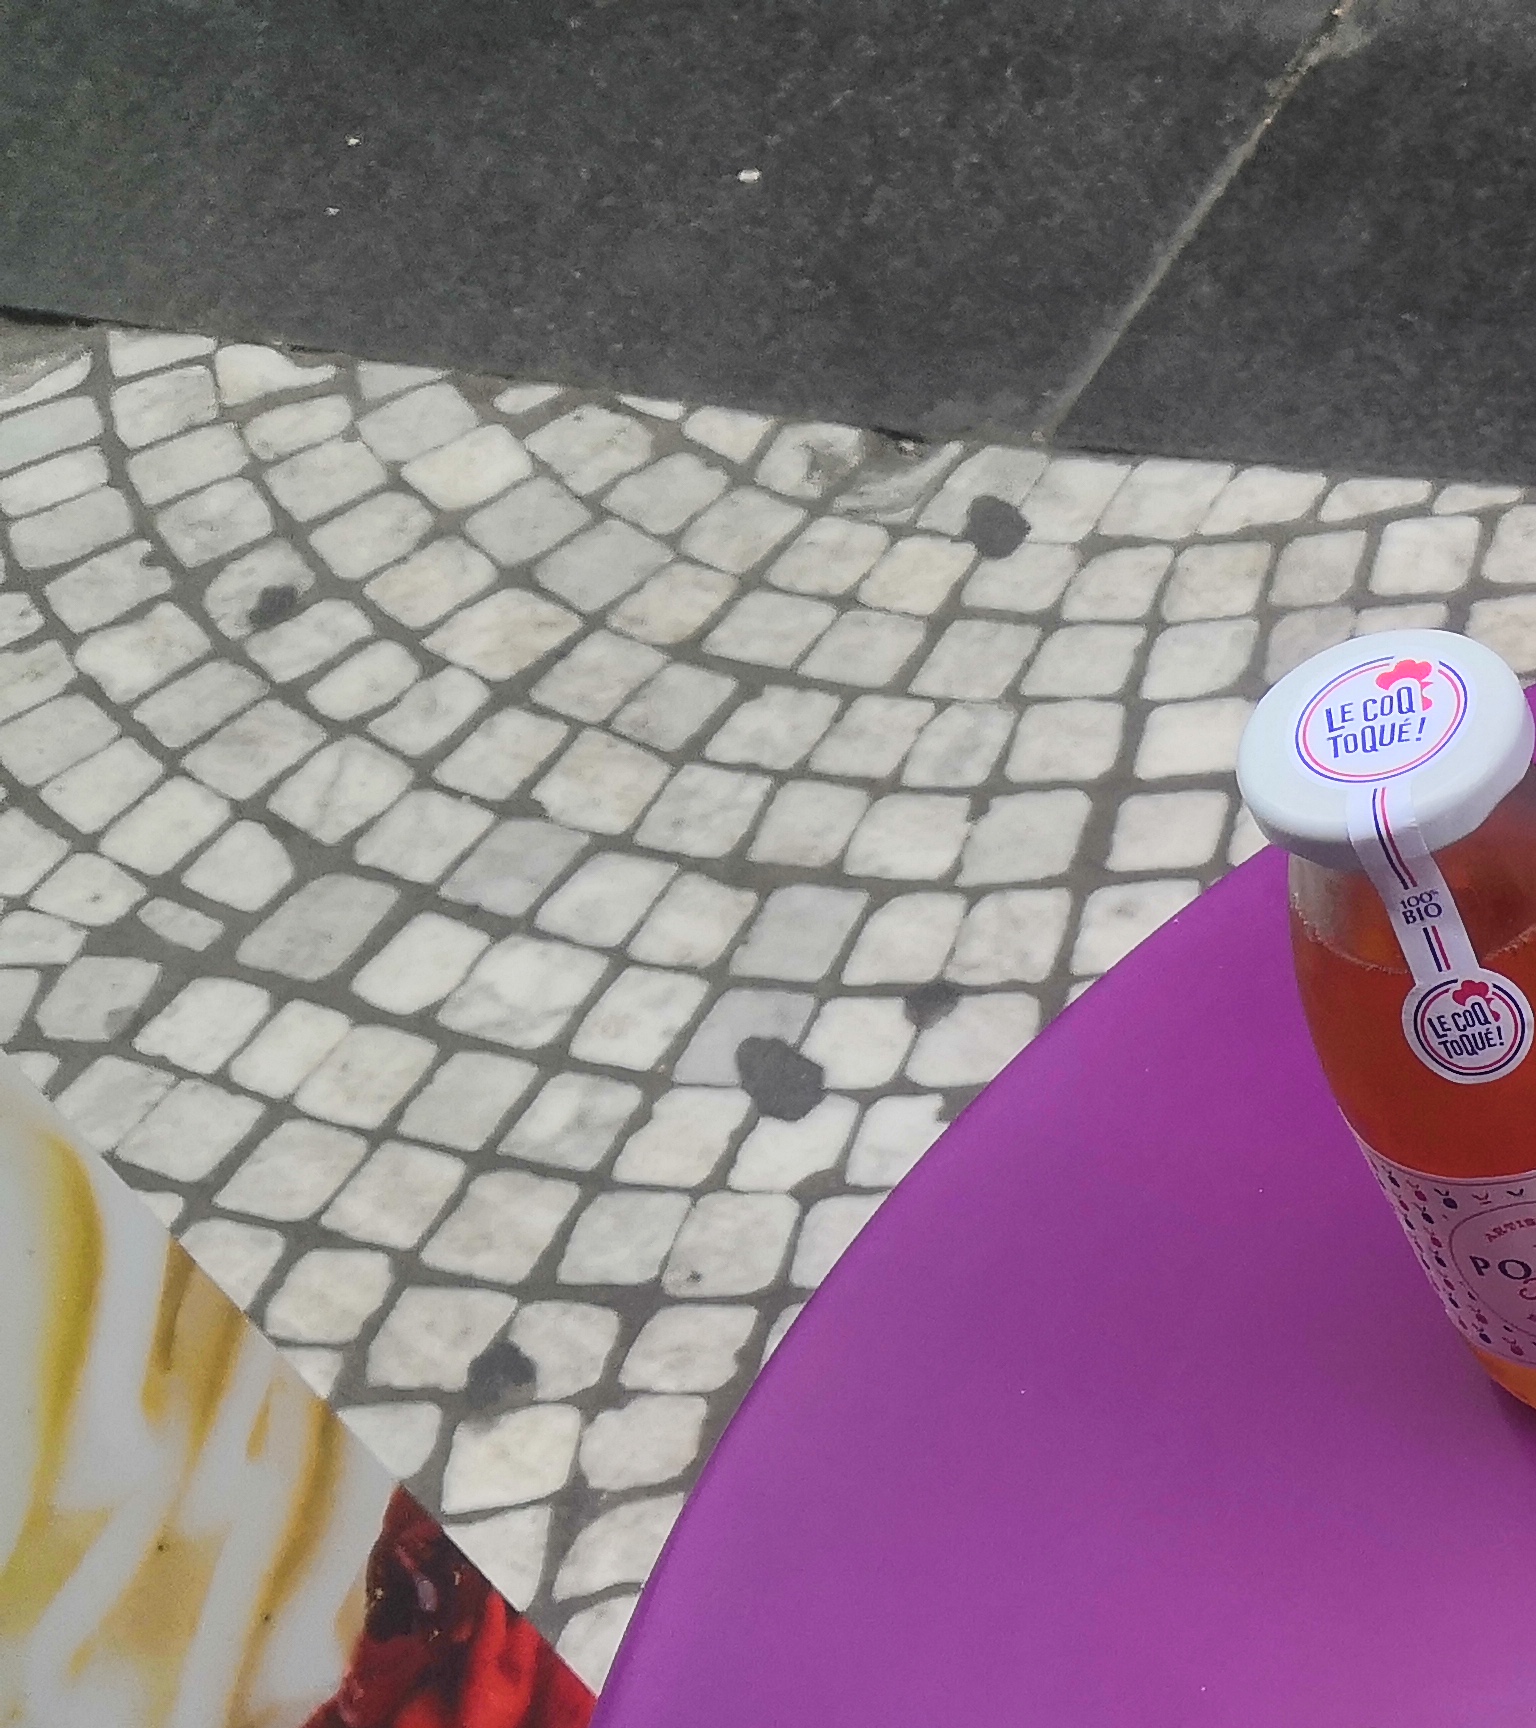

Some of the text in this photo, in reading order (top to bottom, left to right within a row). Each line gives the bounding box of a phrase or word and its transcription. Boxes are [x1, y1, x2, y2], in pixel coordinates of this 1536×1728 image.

[1325, 686, 1415, 733] LE COQ
[1402, 902, 1443, 925] BIO
[1427, 1001, 1492, 1039] LE COQ
